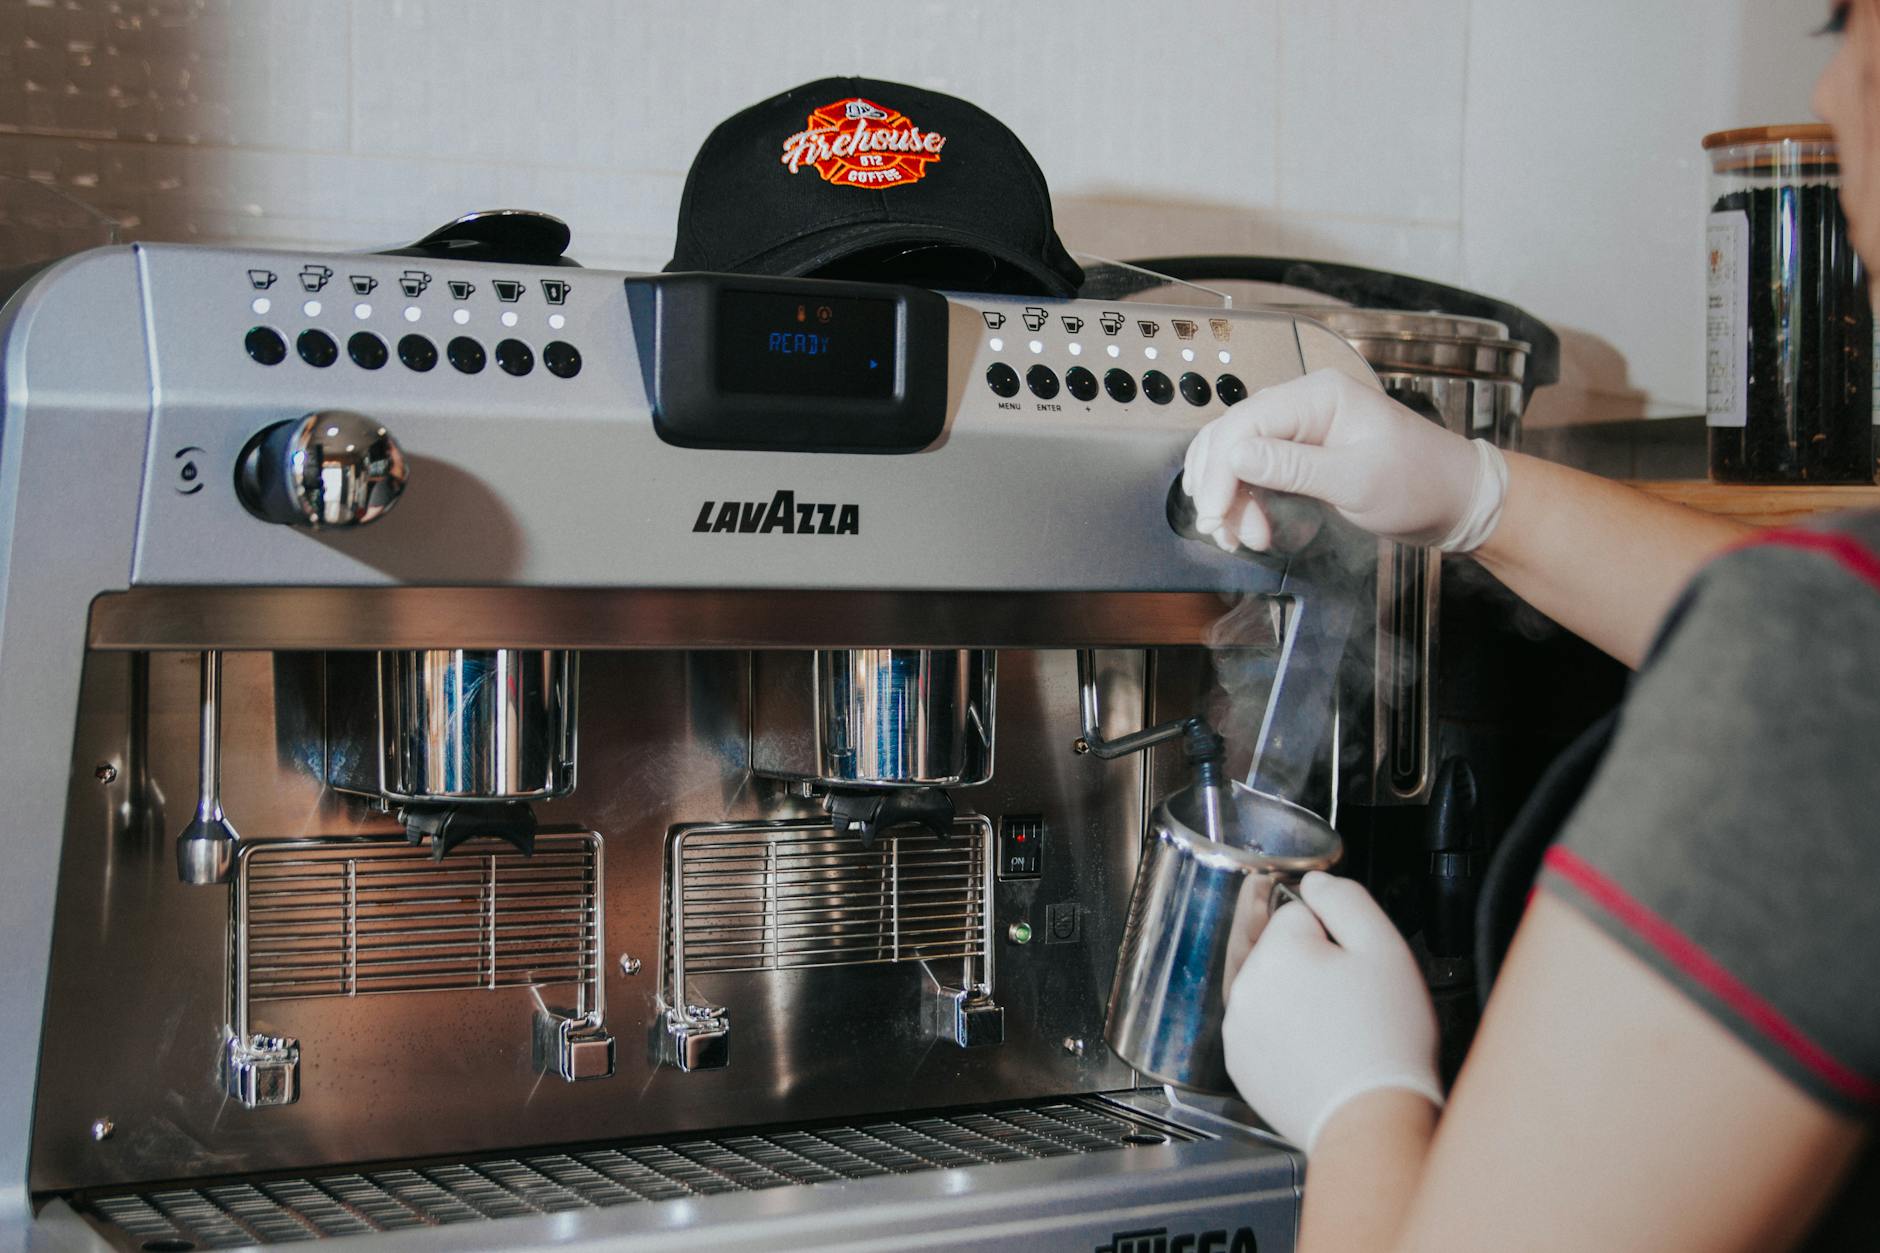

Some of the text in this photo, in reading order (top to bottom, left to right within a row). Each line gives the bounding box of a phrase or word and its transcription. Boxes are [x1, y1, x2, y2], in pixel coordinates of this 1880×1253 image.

[781, 118, 946, 174] Firehouse
[847, 168, 902, 183] COFFEE
[998, 402, 1021, 411] MENU
[1037, 404, 1062, 412] ENTER
[692, 490, 859, 535] LAVAZZA
